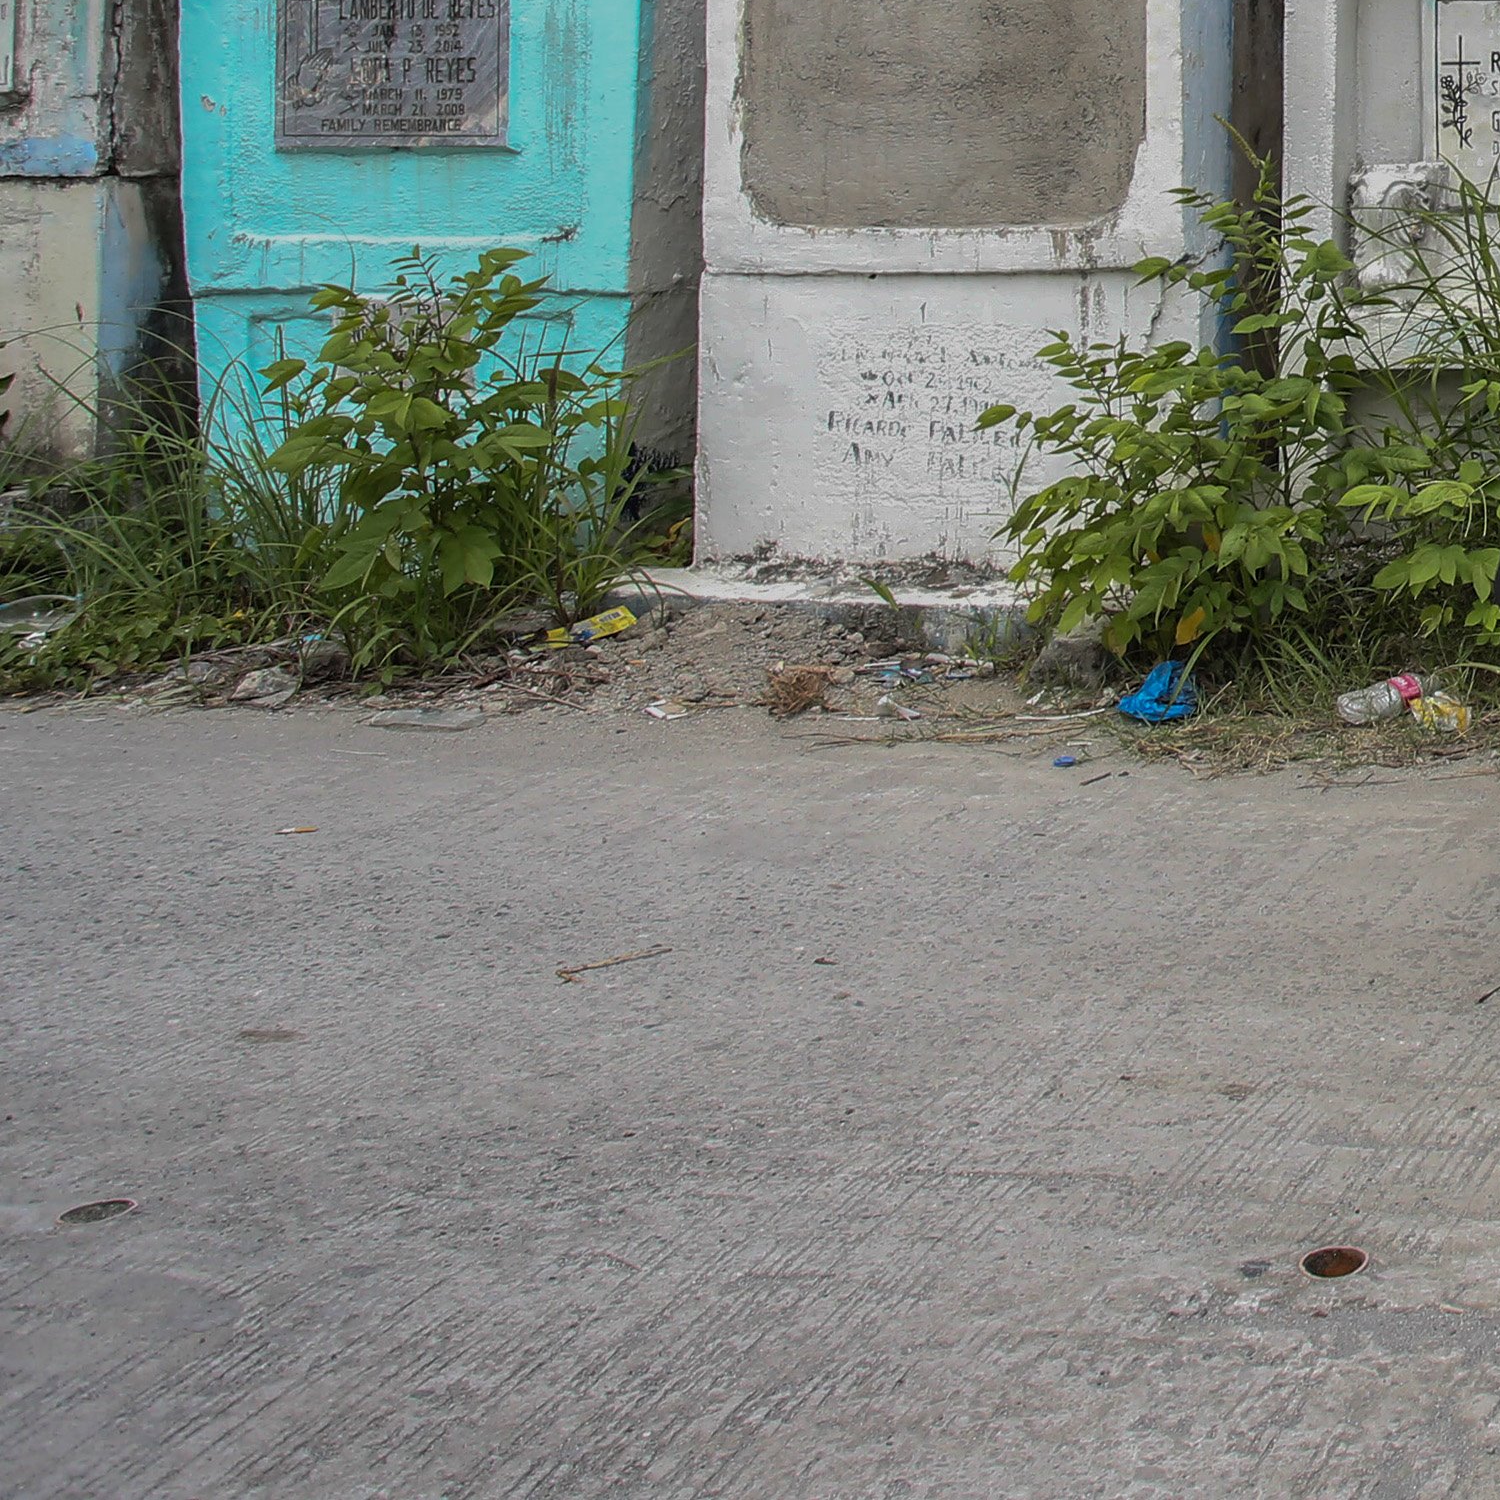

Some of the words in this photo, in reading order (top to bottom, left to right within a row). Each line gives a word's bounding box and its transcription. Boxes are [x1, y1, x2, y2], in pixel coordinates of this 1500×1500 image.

[366, 40, 393, 54] JULY
[436, 40, 464, 53] 2014
[426, 57, 478, 84] REYES
[362, 88, 403, 101] MARCH
[362, 104, 403, 117] MARCH
[435, 103, 466, 117] 2008
[320, 119, 367, 132] FAMILY
[373, 118, 462, 133] REMEMBRANCE
